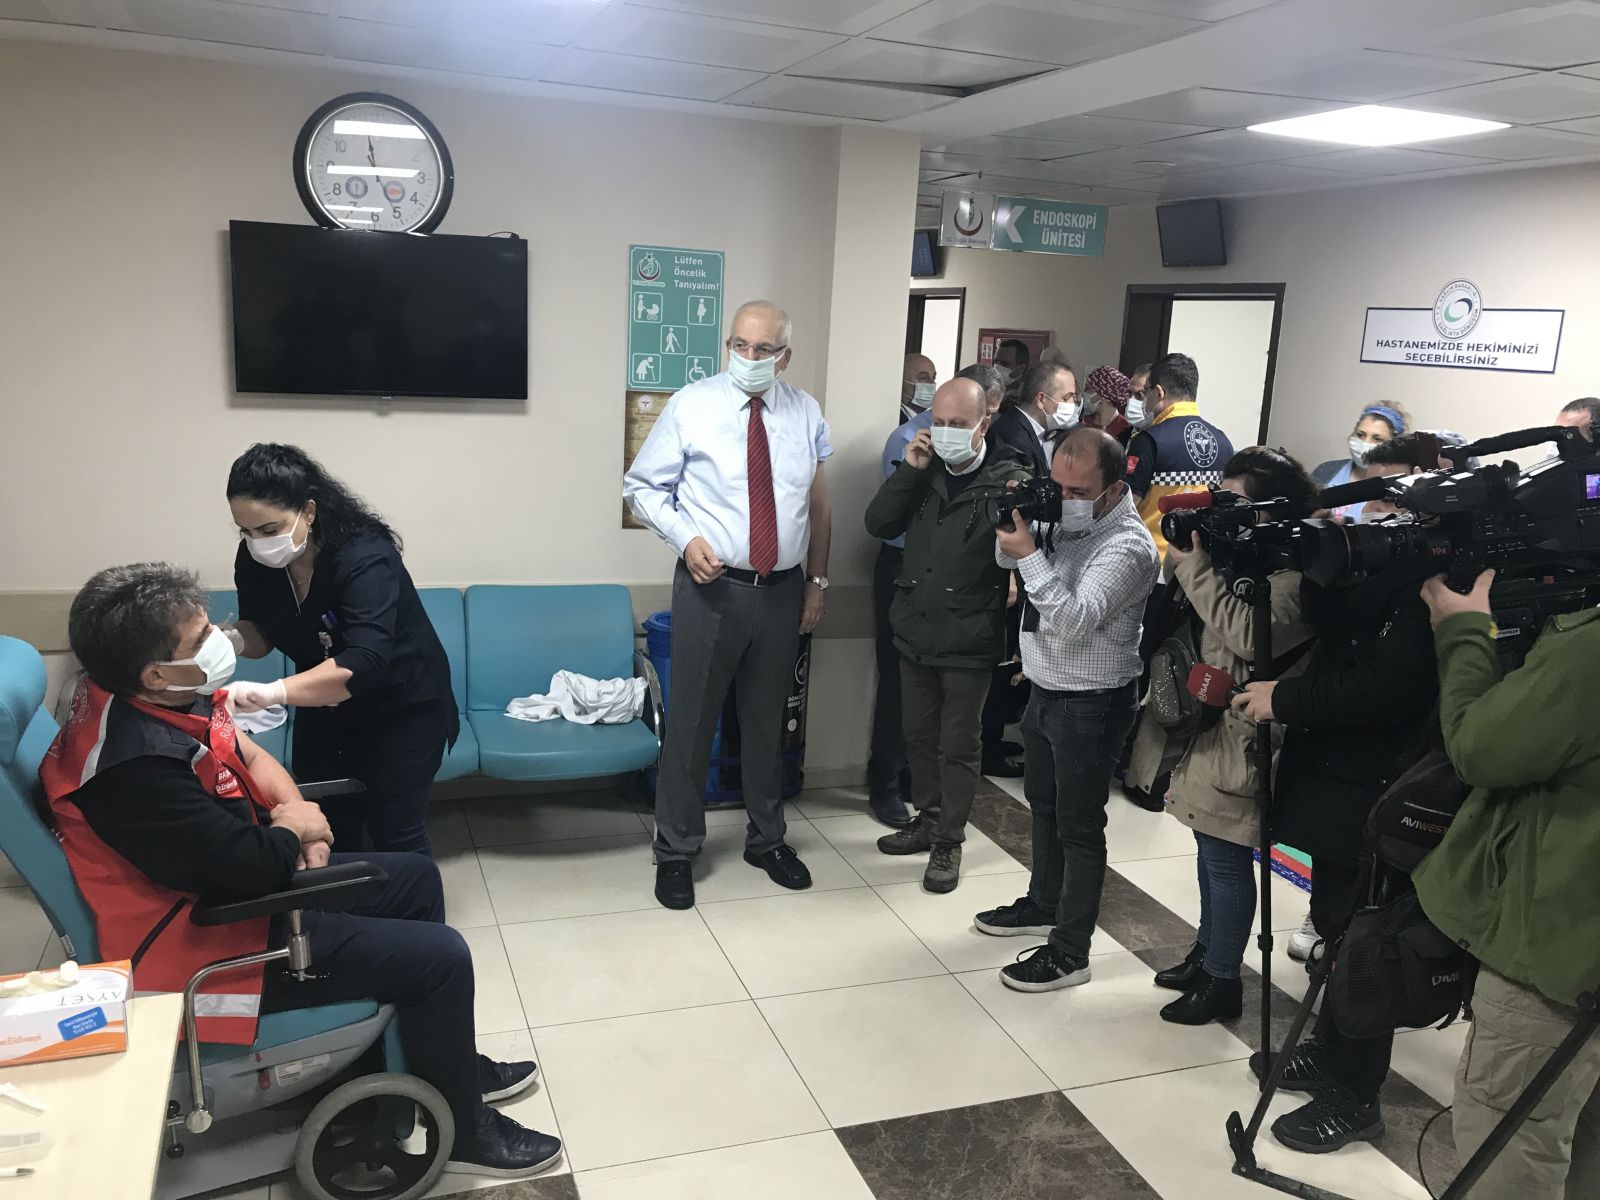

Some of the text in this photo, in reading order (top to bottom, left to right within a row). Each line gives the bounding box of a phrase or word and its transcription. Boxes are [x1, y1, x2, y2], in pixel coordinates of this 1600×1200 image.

[334, 140, 347, 153] 10
[417, 172, 426, 185] 3
[332, 183, 342, 195] 8
[410, 192, 419, 204] 4
[393, 206, 402, 219] 5
[1033, 209, 1097, 230] ENDOSKOPİ
[1041, 228, 1086, 249] ÜNİTESİ
[674, 256, 703, 266] Lütfen
[674, 266, 706, 278] Öncelik
[674, 279, 720, 291] Tanıyalım!
[1376, 339, 1539, 355] HASTANEMİZDE HEKİMİNİZİ
[1405, 352, 1499, 366] SEÇEBİLİRSİNİZ
